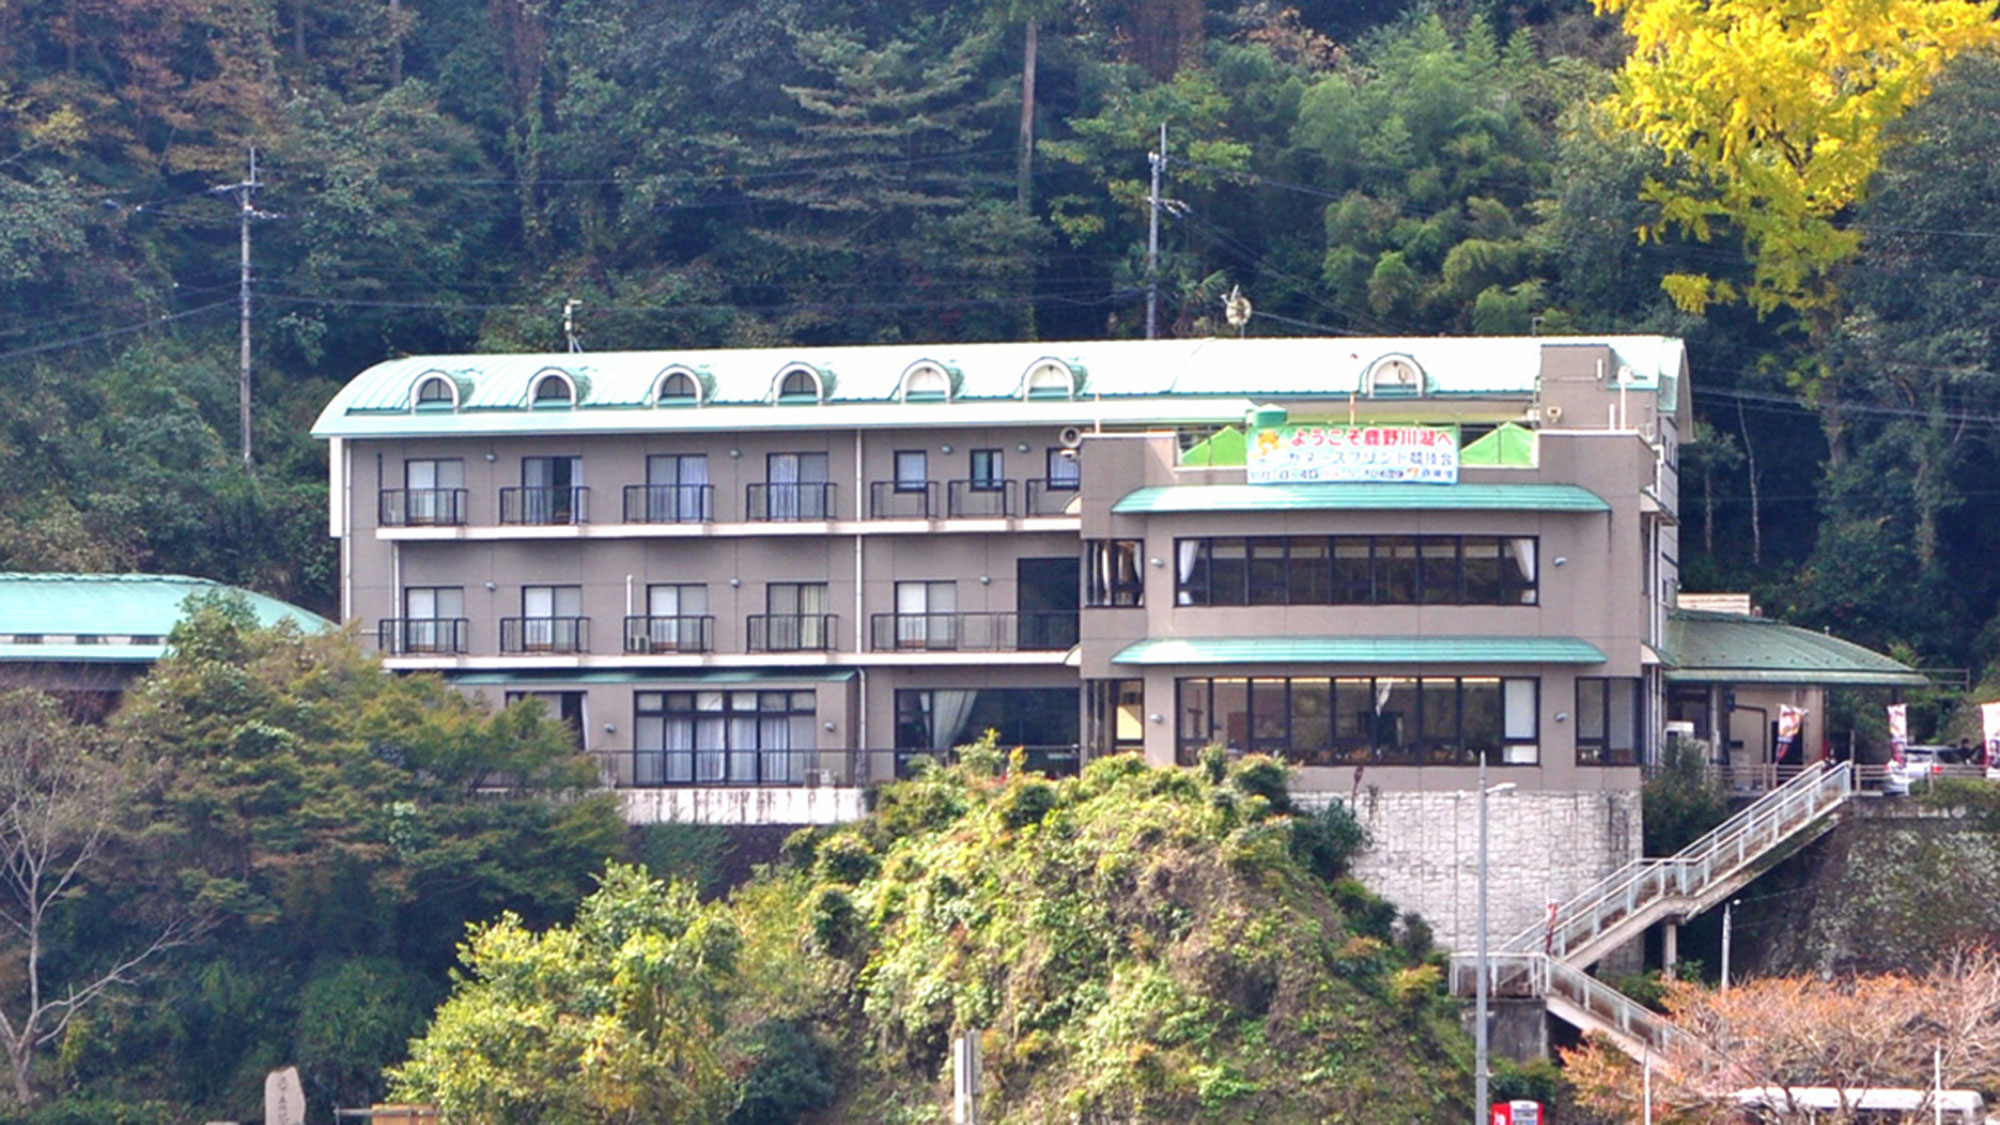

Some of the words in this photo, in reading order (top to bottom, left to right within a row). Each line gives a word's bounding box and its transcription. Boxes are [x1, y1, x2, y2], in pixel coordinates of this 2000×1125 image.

[1291, 429, 1453, 447] ようこそ鹿野川湖へ
